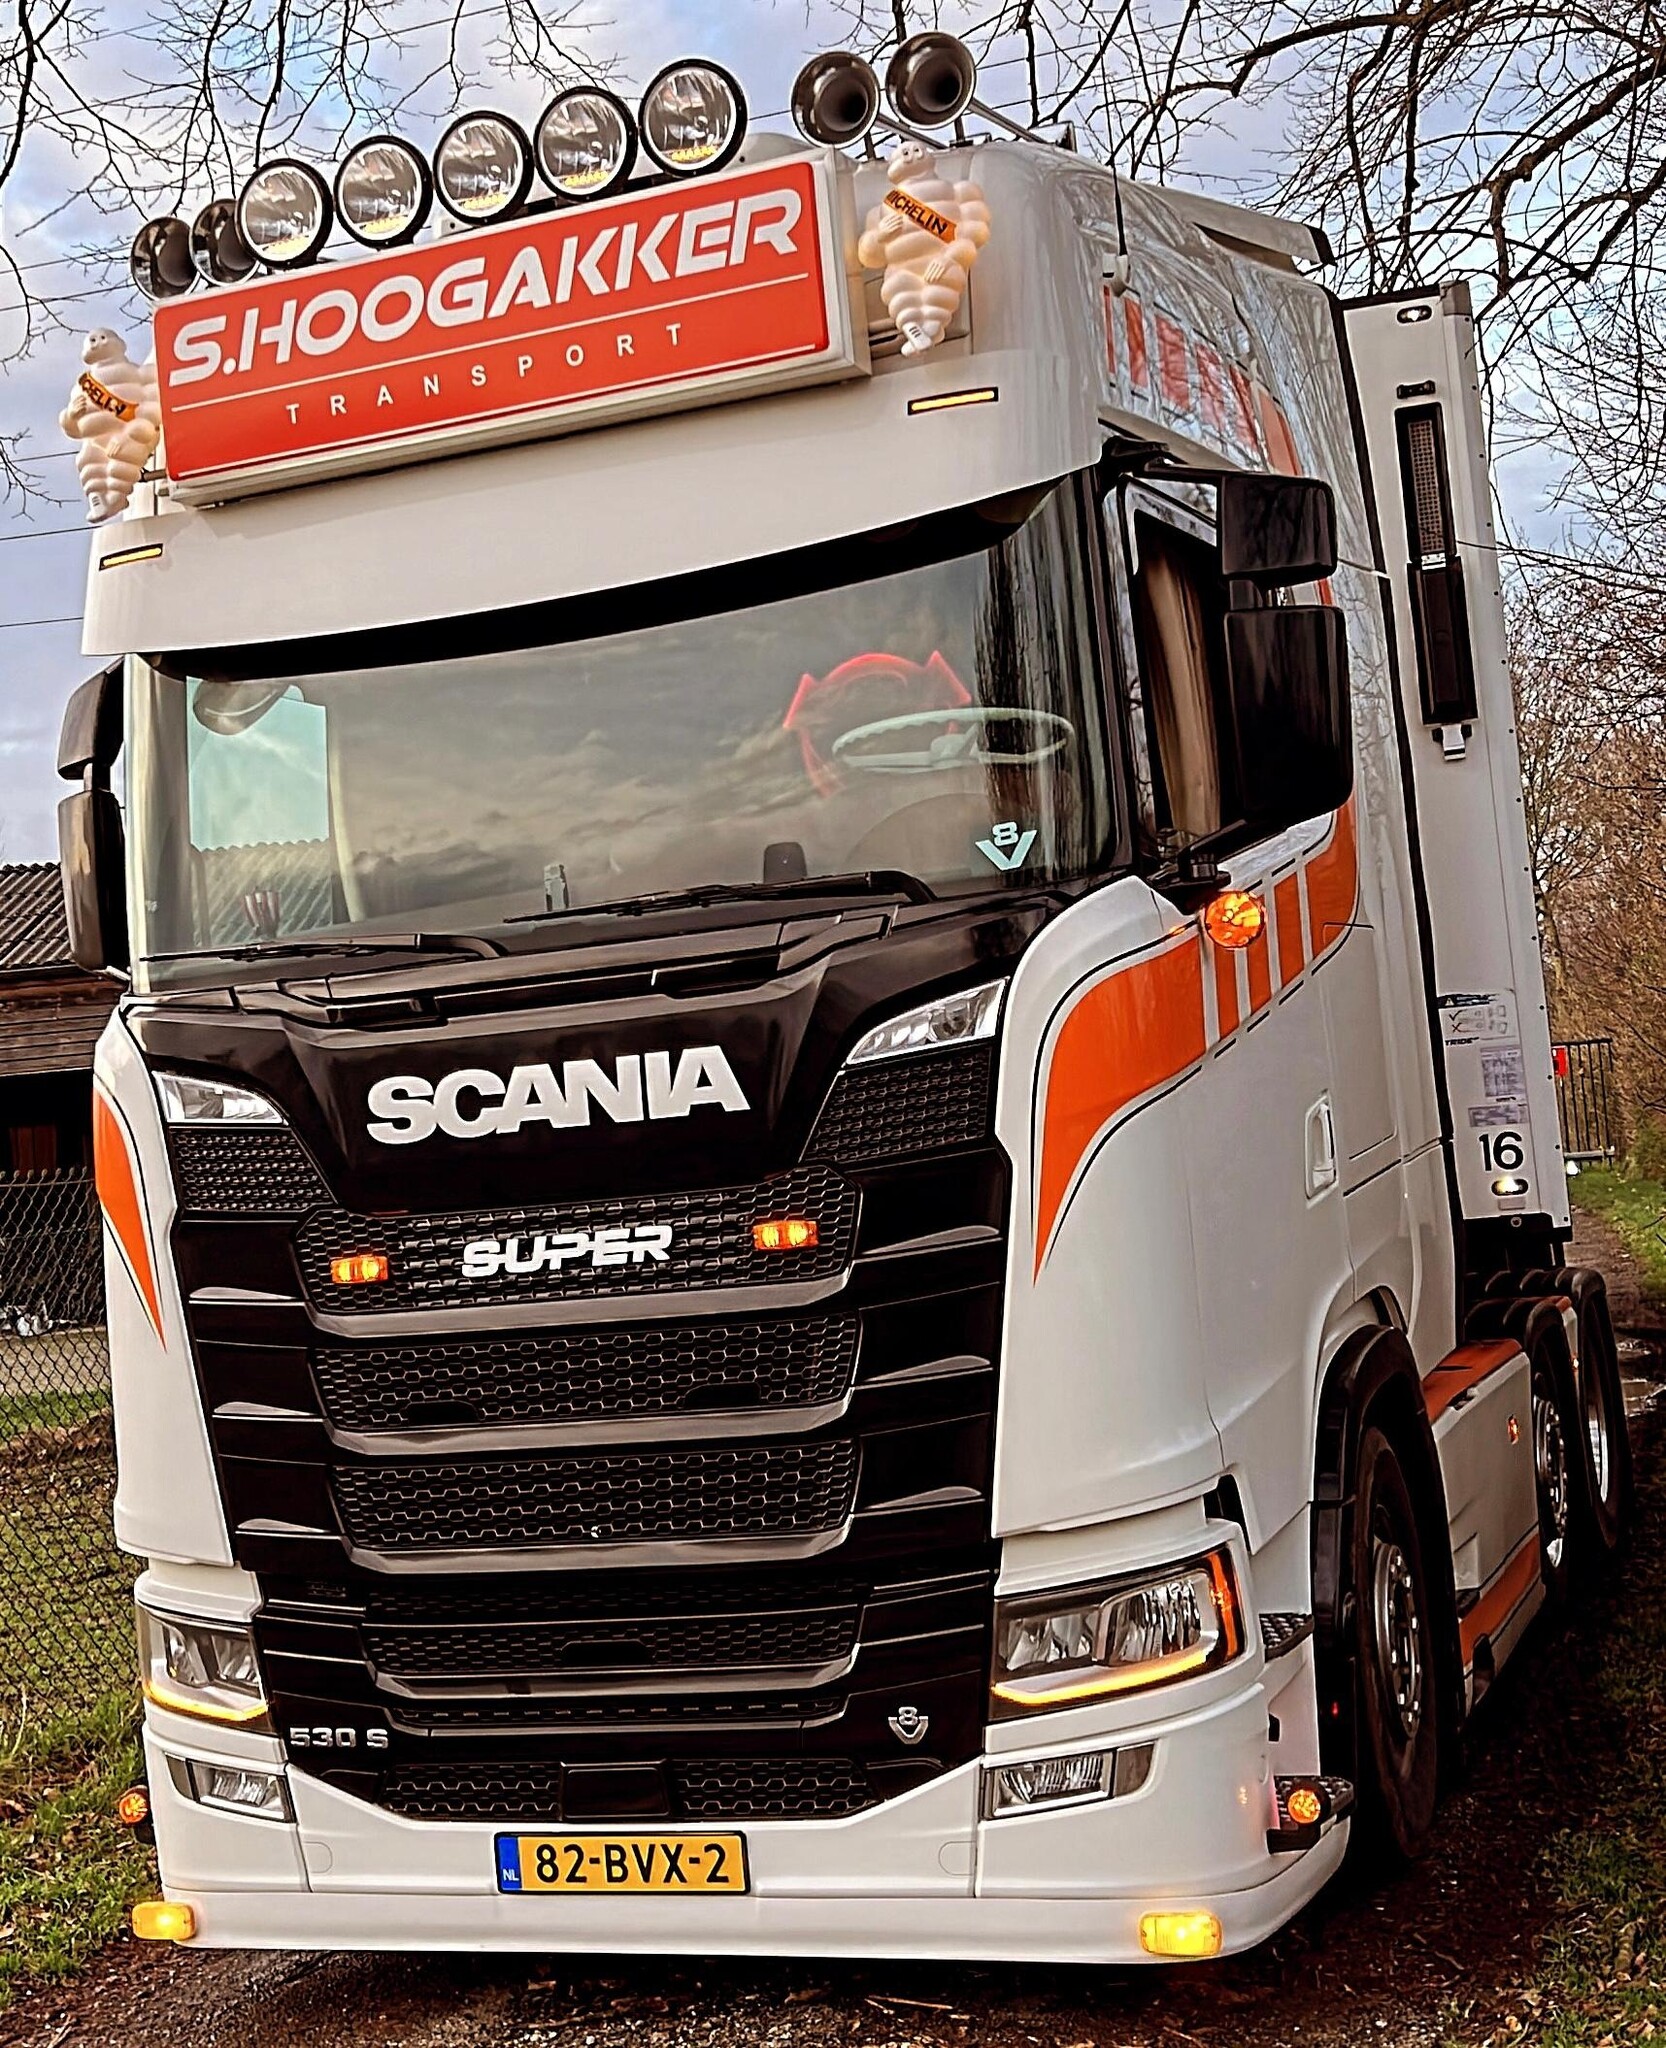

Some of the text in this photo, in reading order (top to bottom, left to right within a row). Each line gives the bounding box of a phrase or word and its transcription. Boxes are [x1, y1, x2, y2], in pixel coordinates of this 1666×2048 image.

[169, 189, 801, 386] S.HOOGAKKER
[286, 323, 681, 424] TRANSPORT
[366, 1045, 750, 1145] SCANIA
[1478, 1131, 1524, 1171] 16
[462, 1225, 672, 1278] SUPER
[290, 1727, 388, 1748] 530 S
[502, 1868, 520, 1881] NL
[536, 1843, 730, 1884] 82-BVX-2
